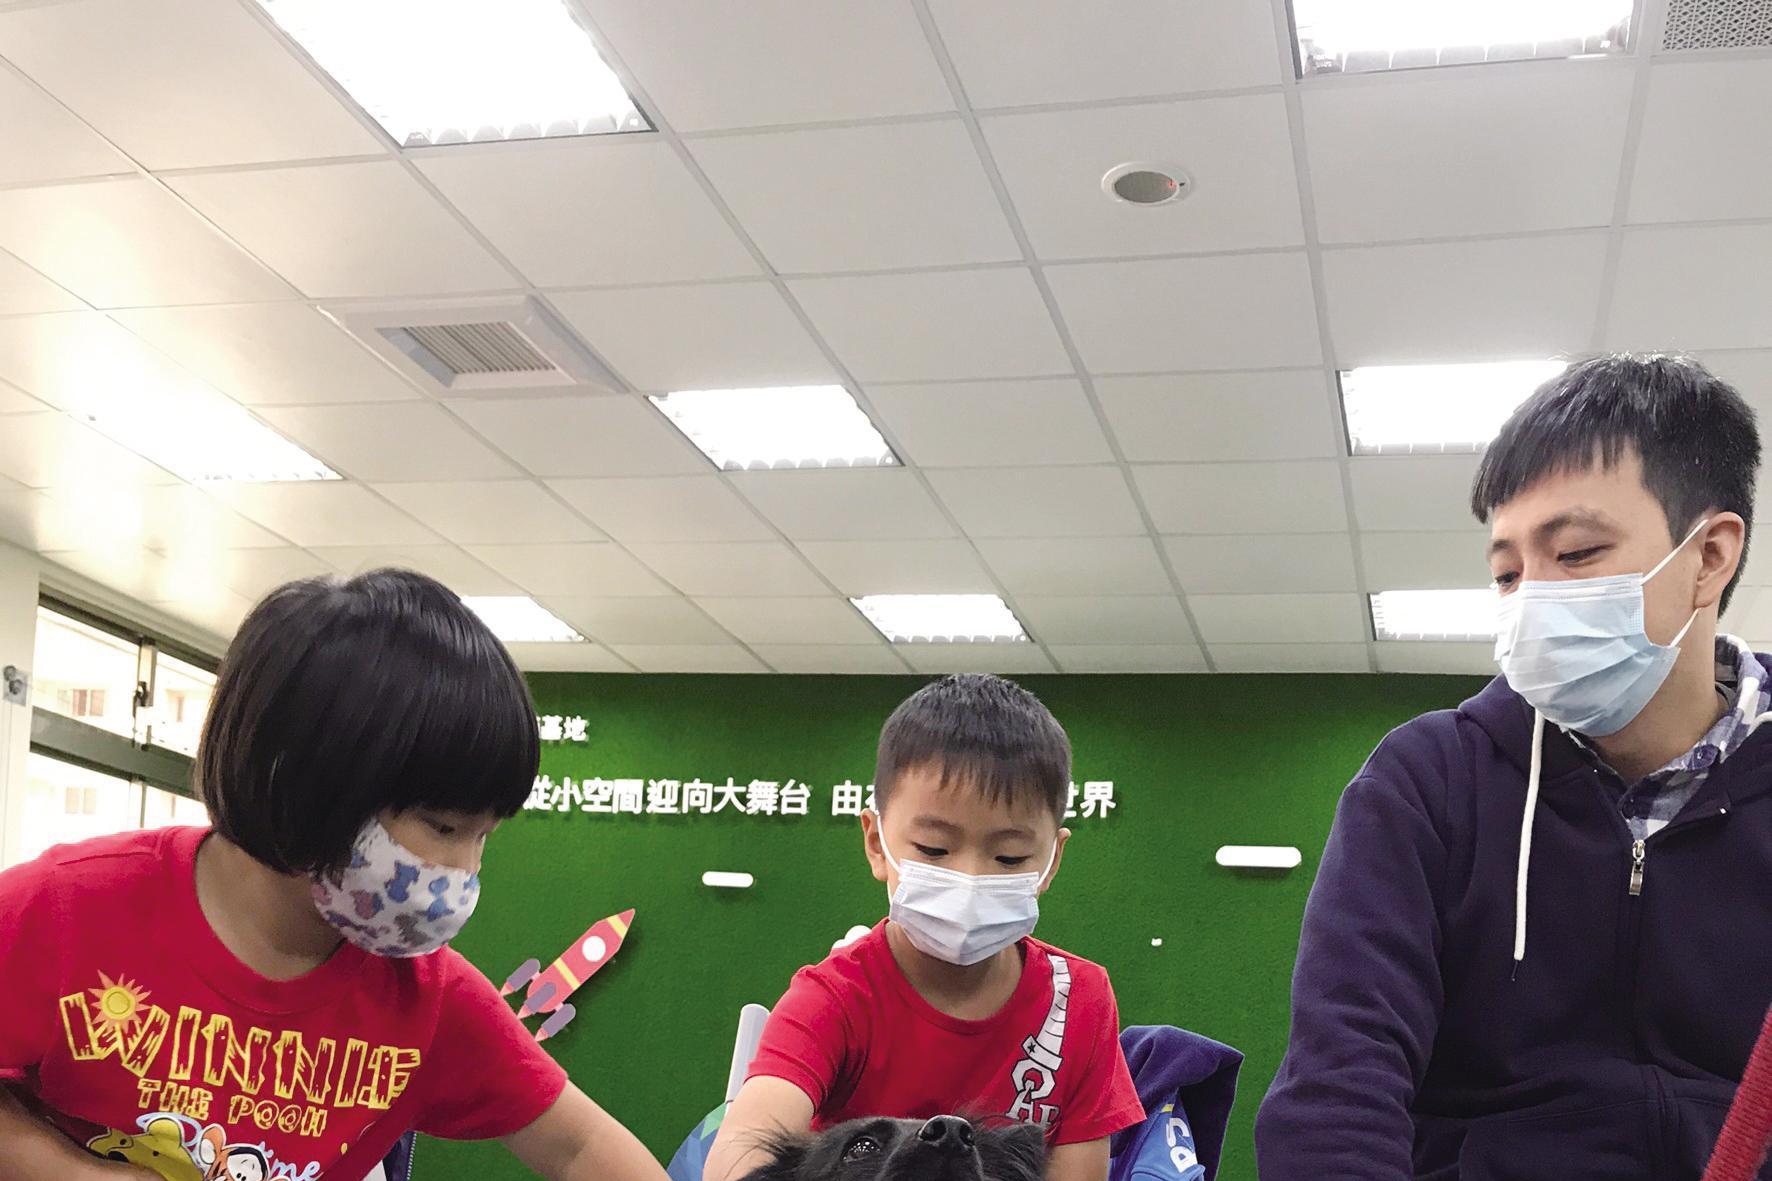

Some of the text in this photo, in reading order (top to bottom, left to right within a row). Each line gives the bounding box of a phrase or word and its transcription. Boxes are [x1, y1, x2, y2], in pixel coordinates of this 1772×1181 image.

[536, 714, 589, 742] 基地
[59, 991, 421, 1109] WINNIE
[137, 1078, 214, 1121] THE
[227, 1094, 328, 1138] POOH
